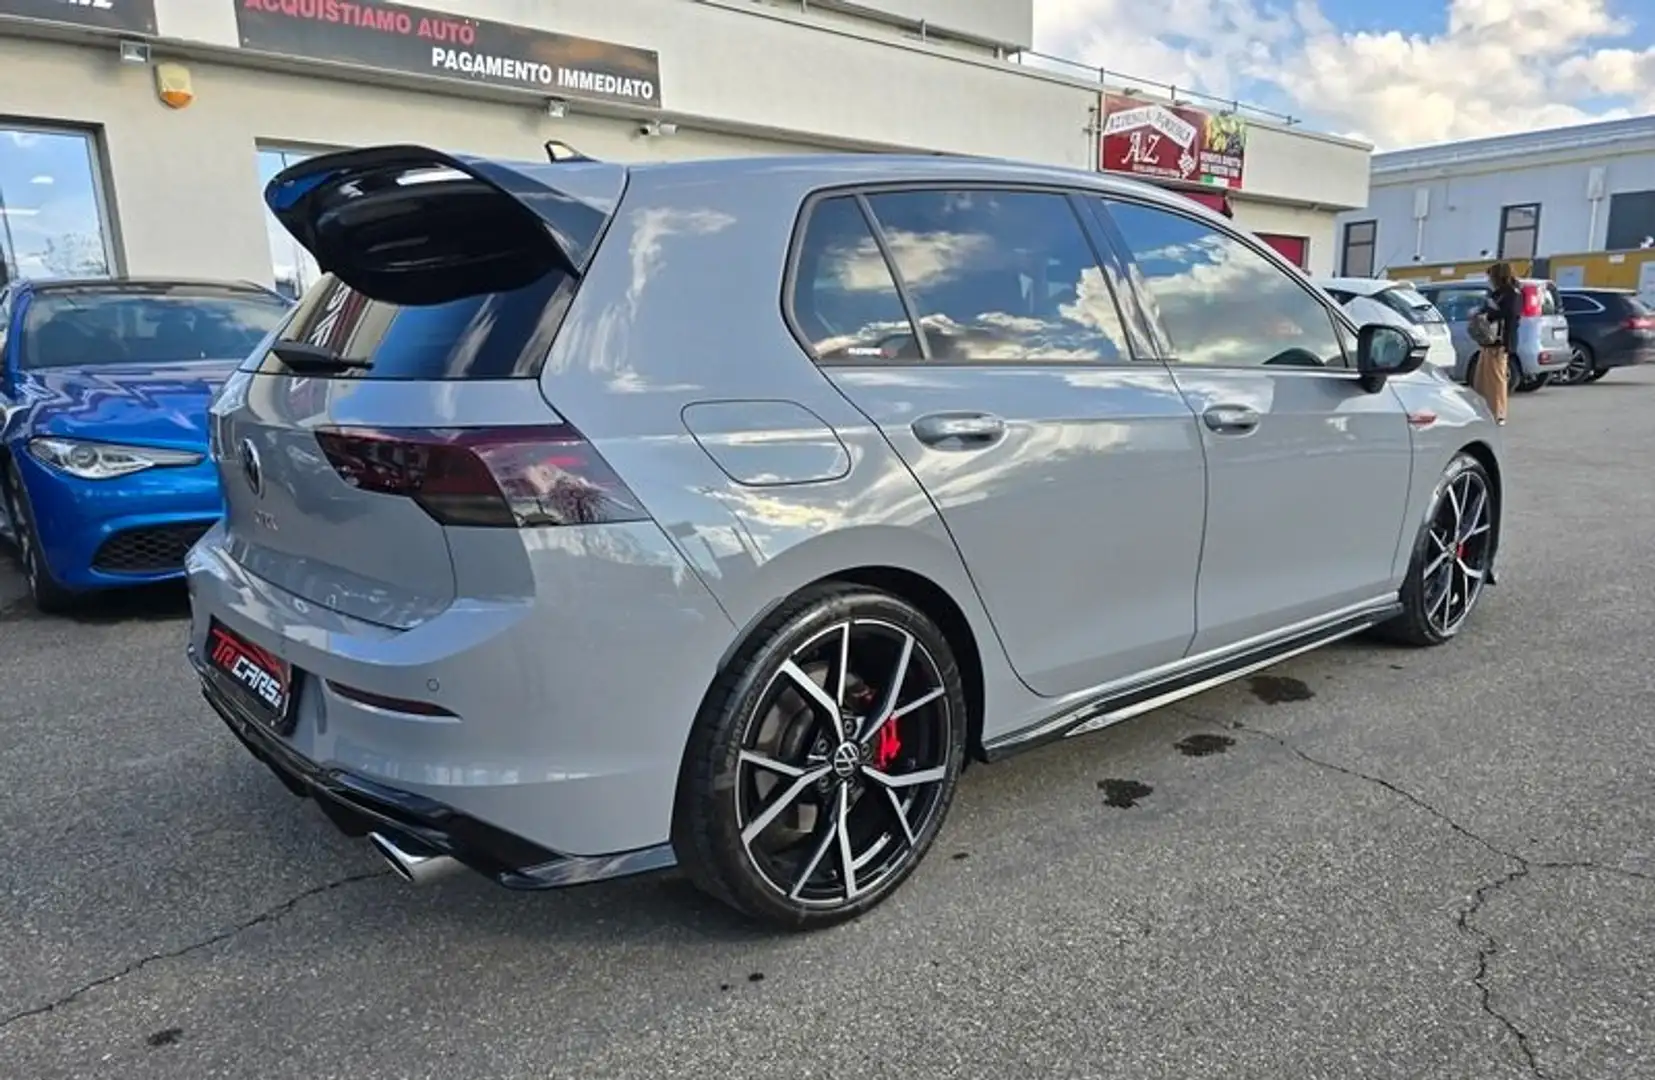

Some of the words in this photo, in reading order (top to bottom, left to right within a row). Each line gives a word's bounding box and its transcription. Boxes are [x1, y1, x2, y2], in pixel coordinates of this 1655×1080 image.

[418, 18, 475, 45] AUTO
[431, 47, 552, 84] PAGAMENTO
[557, 67, 653, 99] IMMEDIATO
